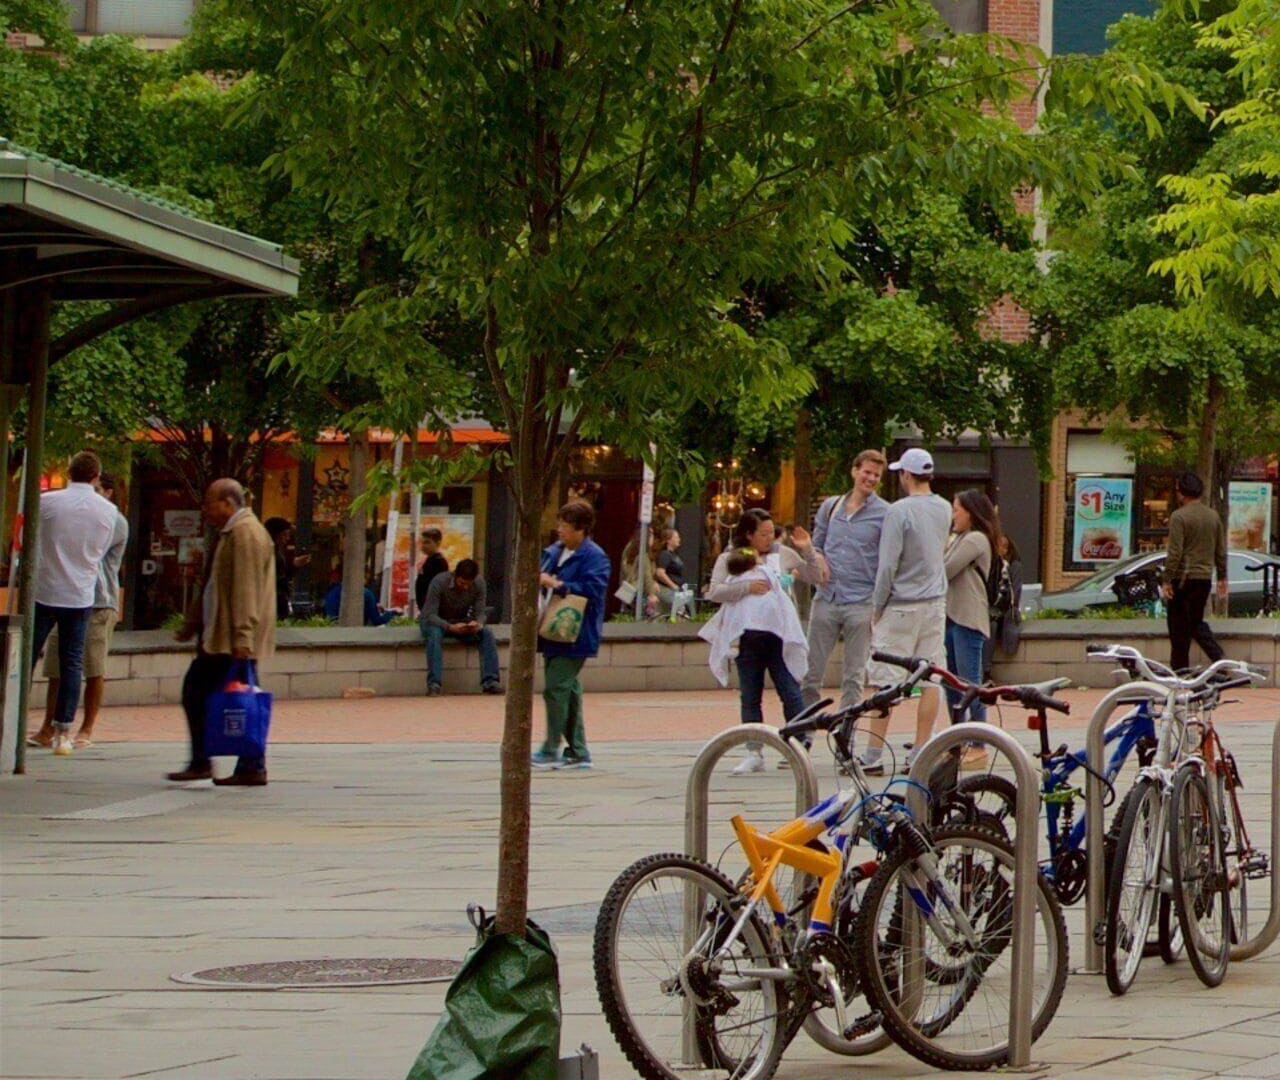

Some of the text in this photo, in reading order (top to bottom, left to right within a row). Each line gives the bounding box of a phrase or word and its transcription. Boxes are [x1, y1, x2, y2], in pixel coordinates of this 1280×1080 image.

[1081, 491, 1125, 514] $1 Any
[1104, 501, 1125, 511] Size
